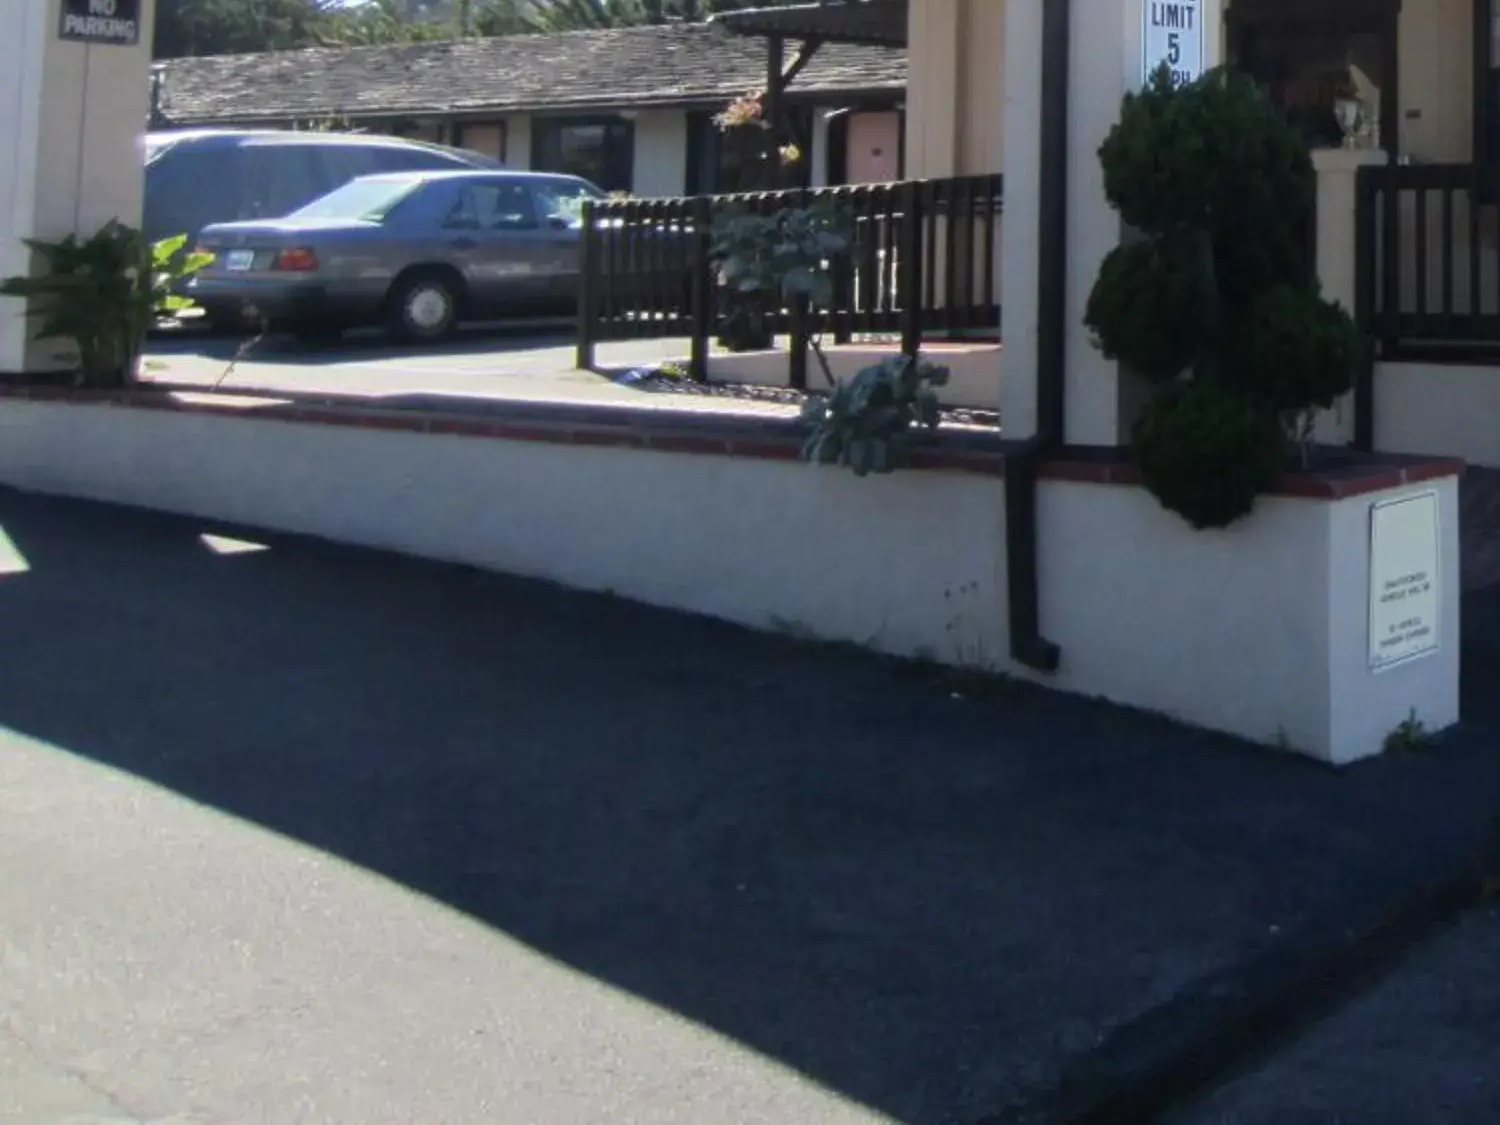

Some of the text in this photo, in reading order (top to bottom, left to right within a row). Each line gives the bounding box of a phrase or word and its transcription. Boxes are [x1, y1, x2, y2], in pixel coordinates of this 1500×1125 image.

[64, 13, 136, 38] PARKING
[1152, 2, 1195, 29] LIMIT
[1167, 32, 1180, 64] 5
